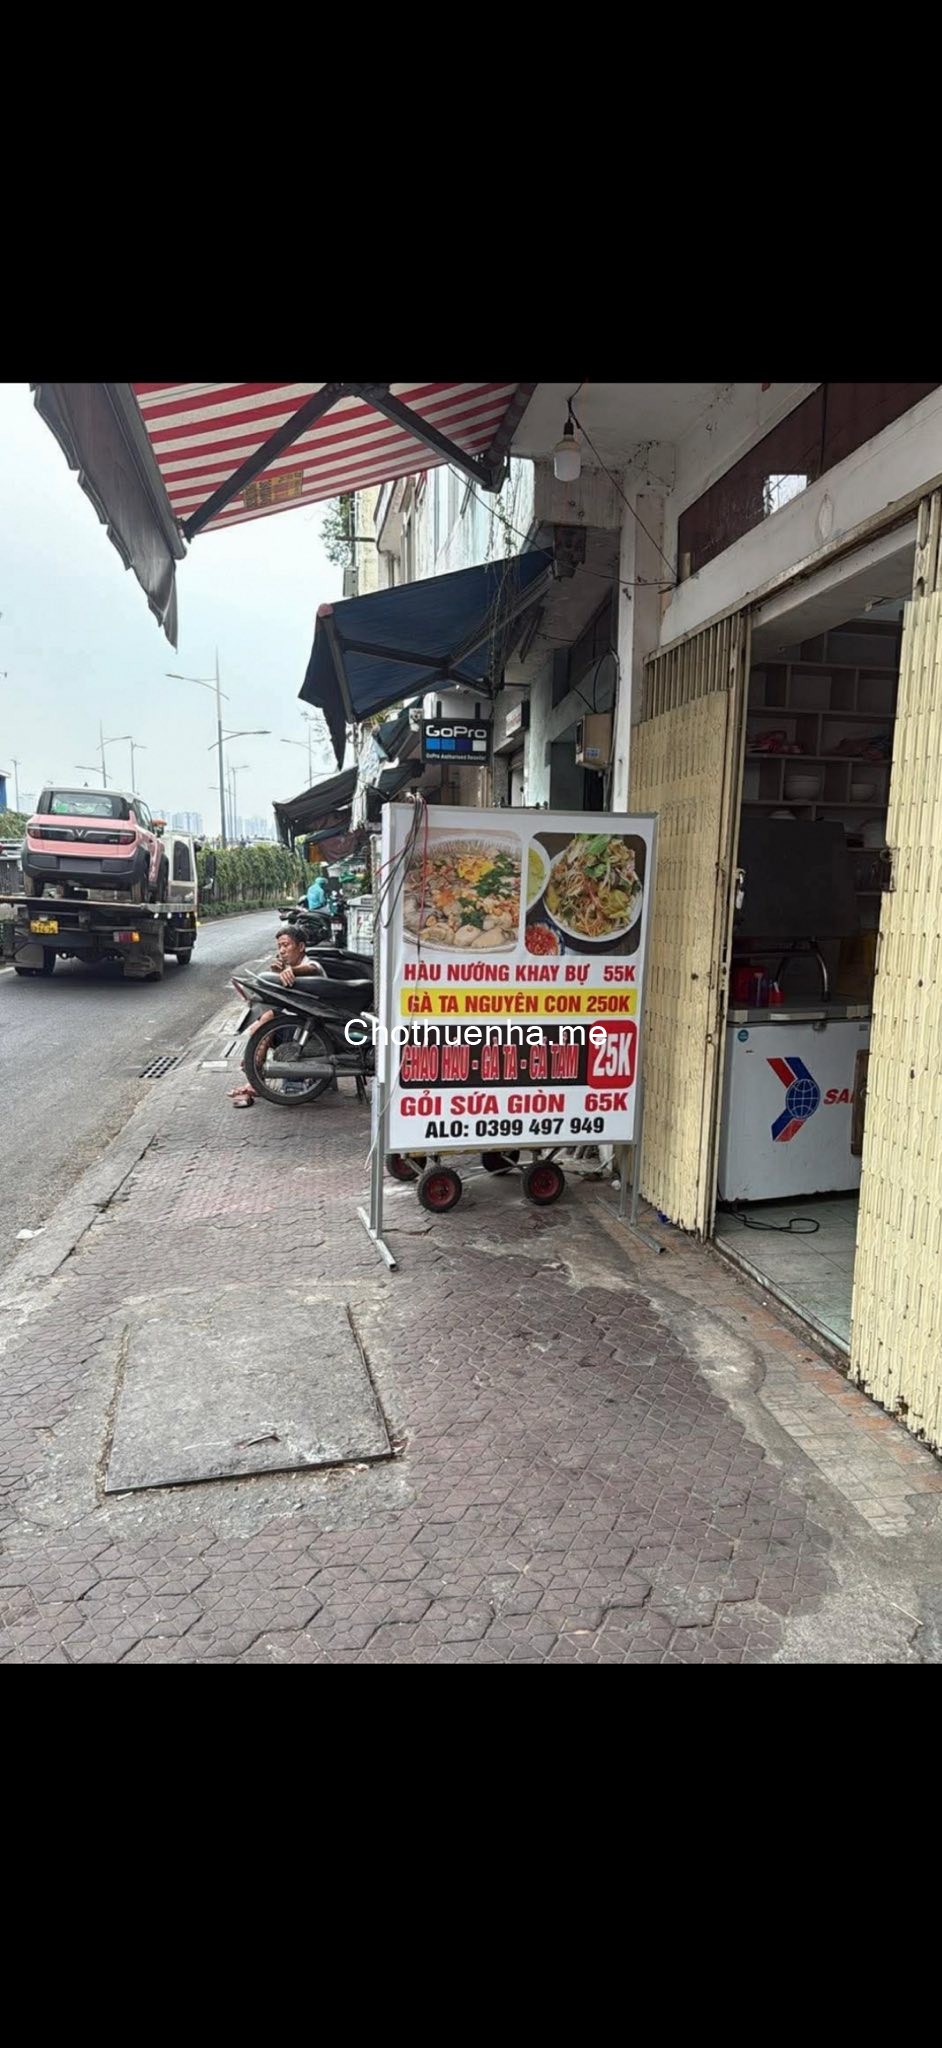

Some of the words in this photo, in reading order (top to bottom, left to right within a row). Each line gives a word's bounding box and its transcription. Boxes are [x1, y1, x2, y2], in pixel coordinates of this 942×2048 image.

[426, 725, 487, 738] GoPro
[404, 960, 441, 981] HÀU
[447, 961, 510, 982] NƯỚNG
[515, 965, 560, 982] KHAY
[565, 963, 590, 986] BỰ
[603, 965, 636, 982] 55K
[407, 991, 433, 1013] GÀ
[438, 995, 459, 1013] TA
[465, 992, 539, 1013] NGUYÊN
[544, 995, 582, 1013] CON
[586, 995, 630, 1013] 250K
[503, 1044, 518, 1080] TA
[592, 1033, 633, 1077] 25K
[400, 1090, 442, 1116] GỎI
[450, 1091, 499, 1115] SỨA
[507, 1089, 565, 1114] GIÒN
[584, 1092, 628, 1112] 65K
[425, 1121, 469, 1139] ALO:
[475, 1119, 523, 1137] 0399
[529, 1118, 564, 1135] 497
[570, 1117, 604, 1134] 949
